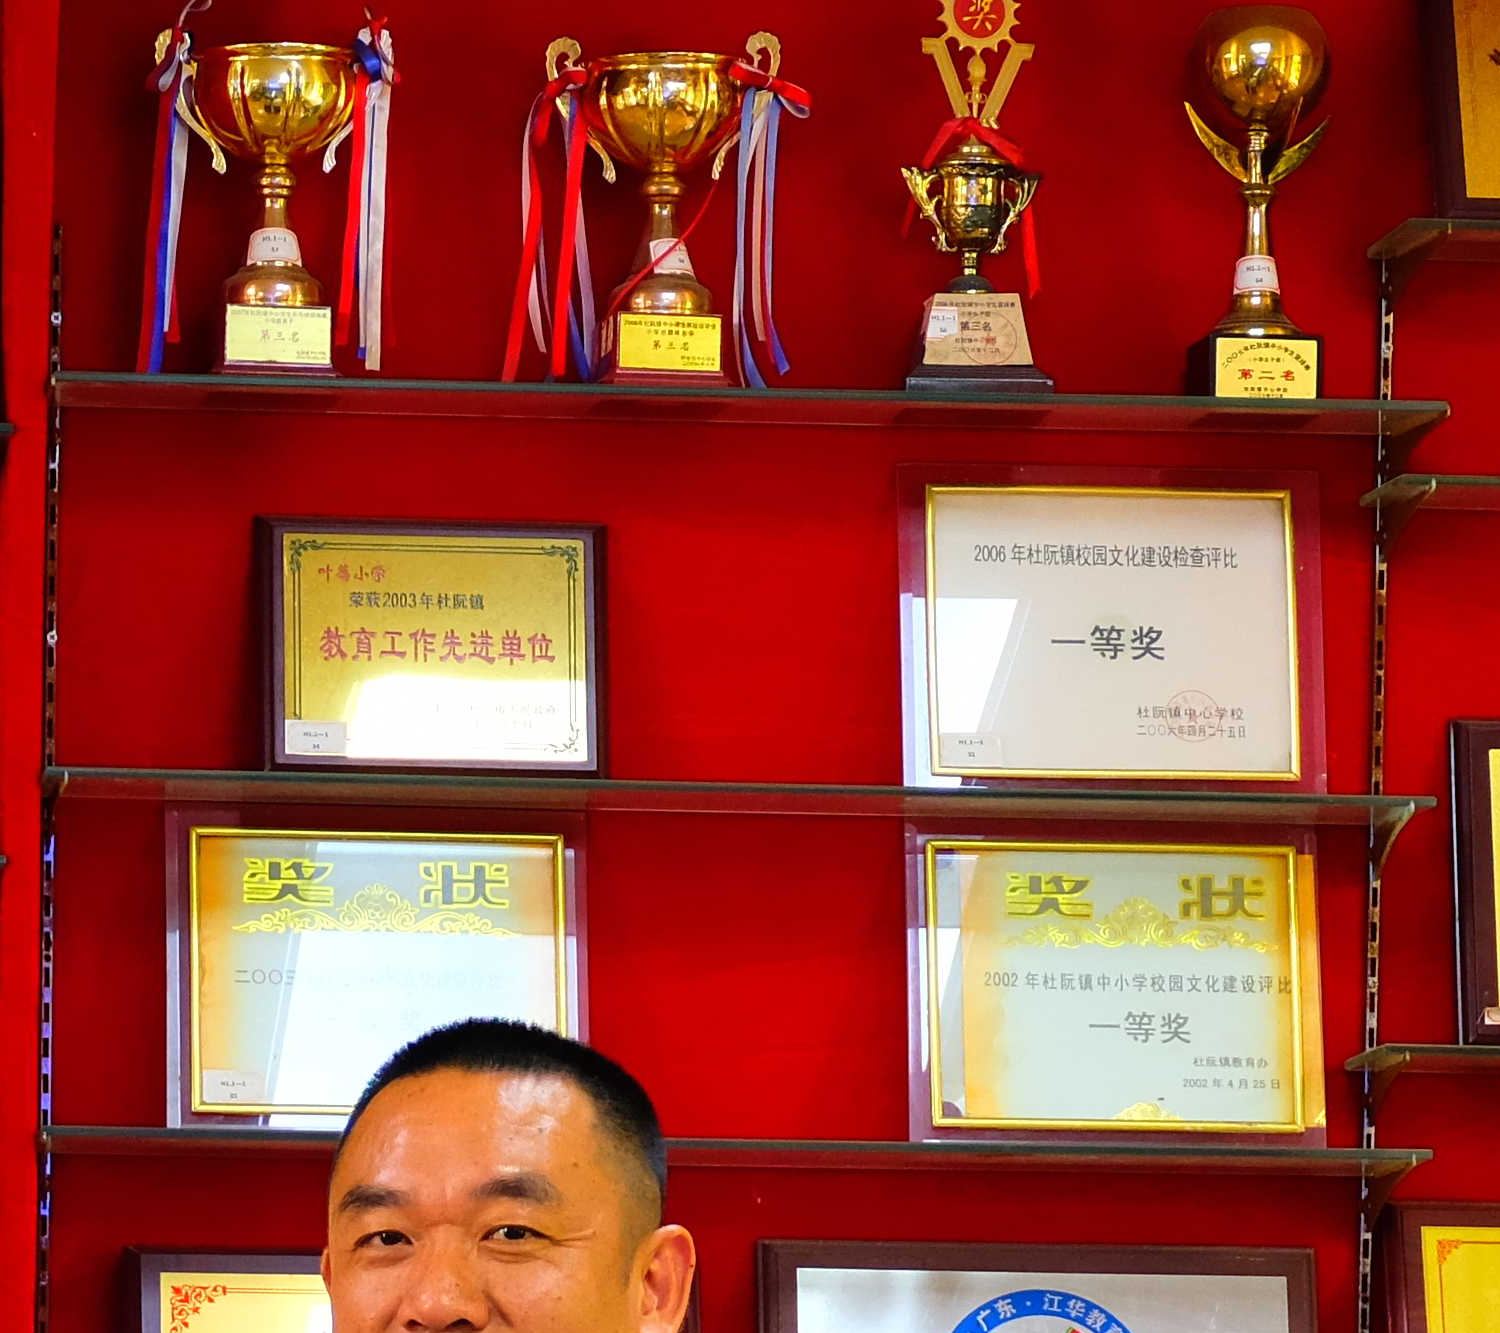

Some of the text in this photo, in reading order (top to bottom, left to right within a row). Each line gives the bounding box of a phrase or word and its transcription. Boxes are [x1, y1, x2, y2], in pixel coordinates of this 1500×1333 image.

[960, 321, 992, 332] 第三名
[1238, 368, 1295, 381] 第二名
[349, 591, 485, 611] 荣获2003年杜阮镇
[319, 626, 556, 666] 教育工作先进单位
[1050, 624, 1166, 662] 一等奖
[1136, 706, 1245, 721] 杜阮镇中心学校
[243, 857, 510, 909] 奖状
[1007, 872, 1266, 921] 奖状
[1089, 1010, 1191, 1044] 一等奖
[1193, 1056, 1268, 1069] 杜阮镇教育办
